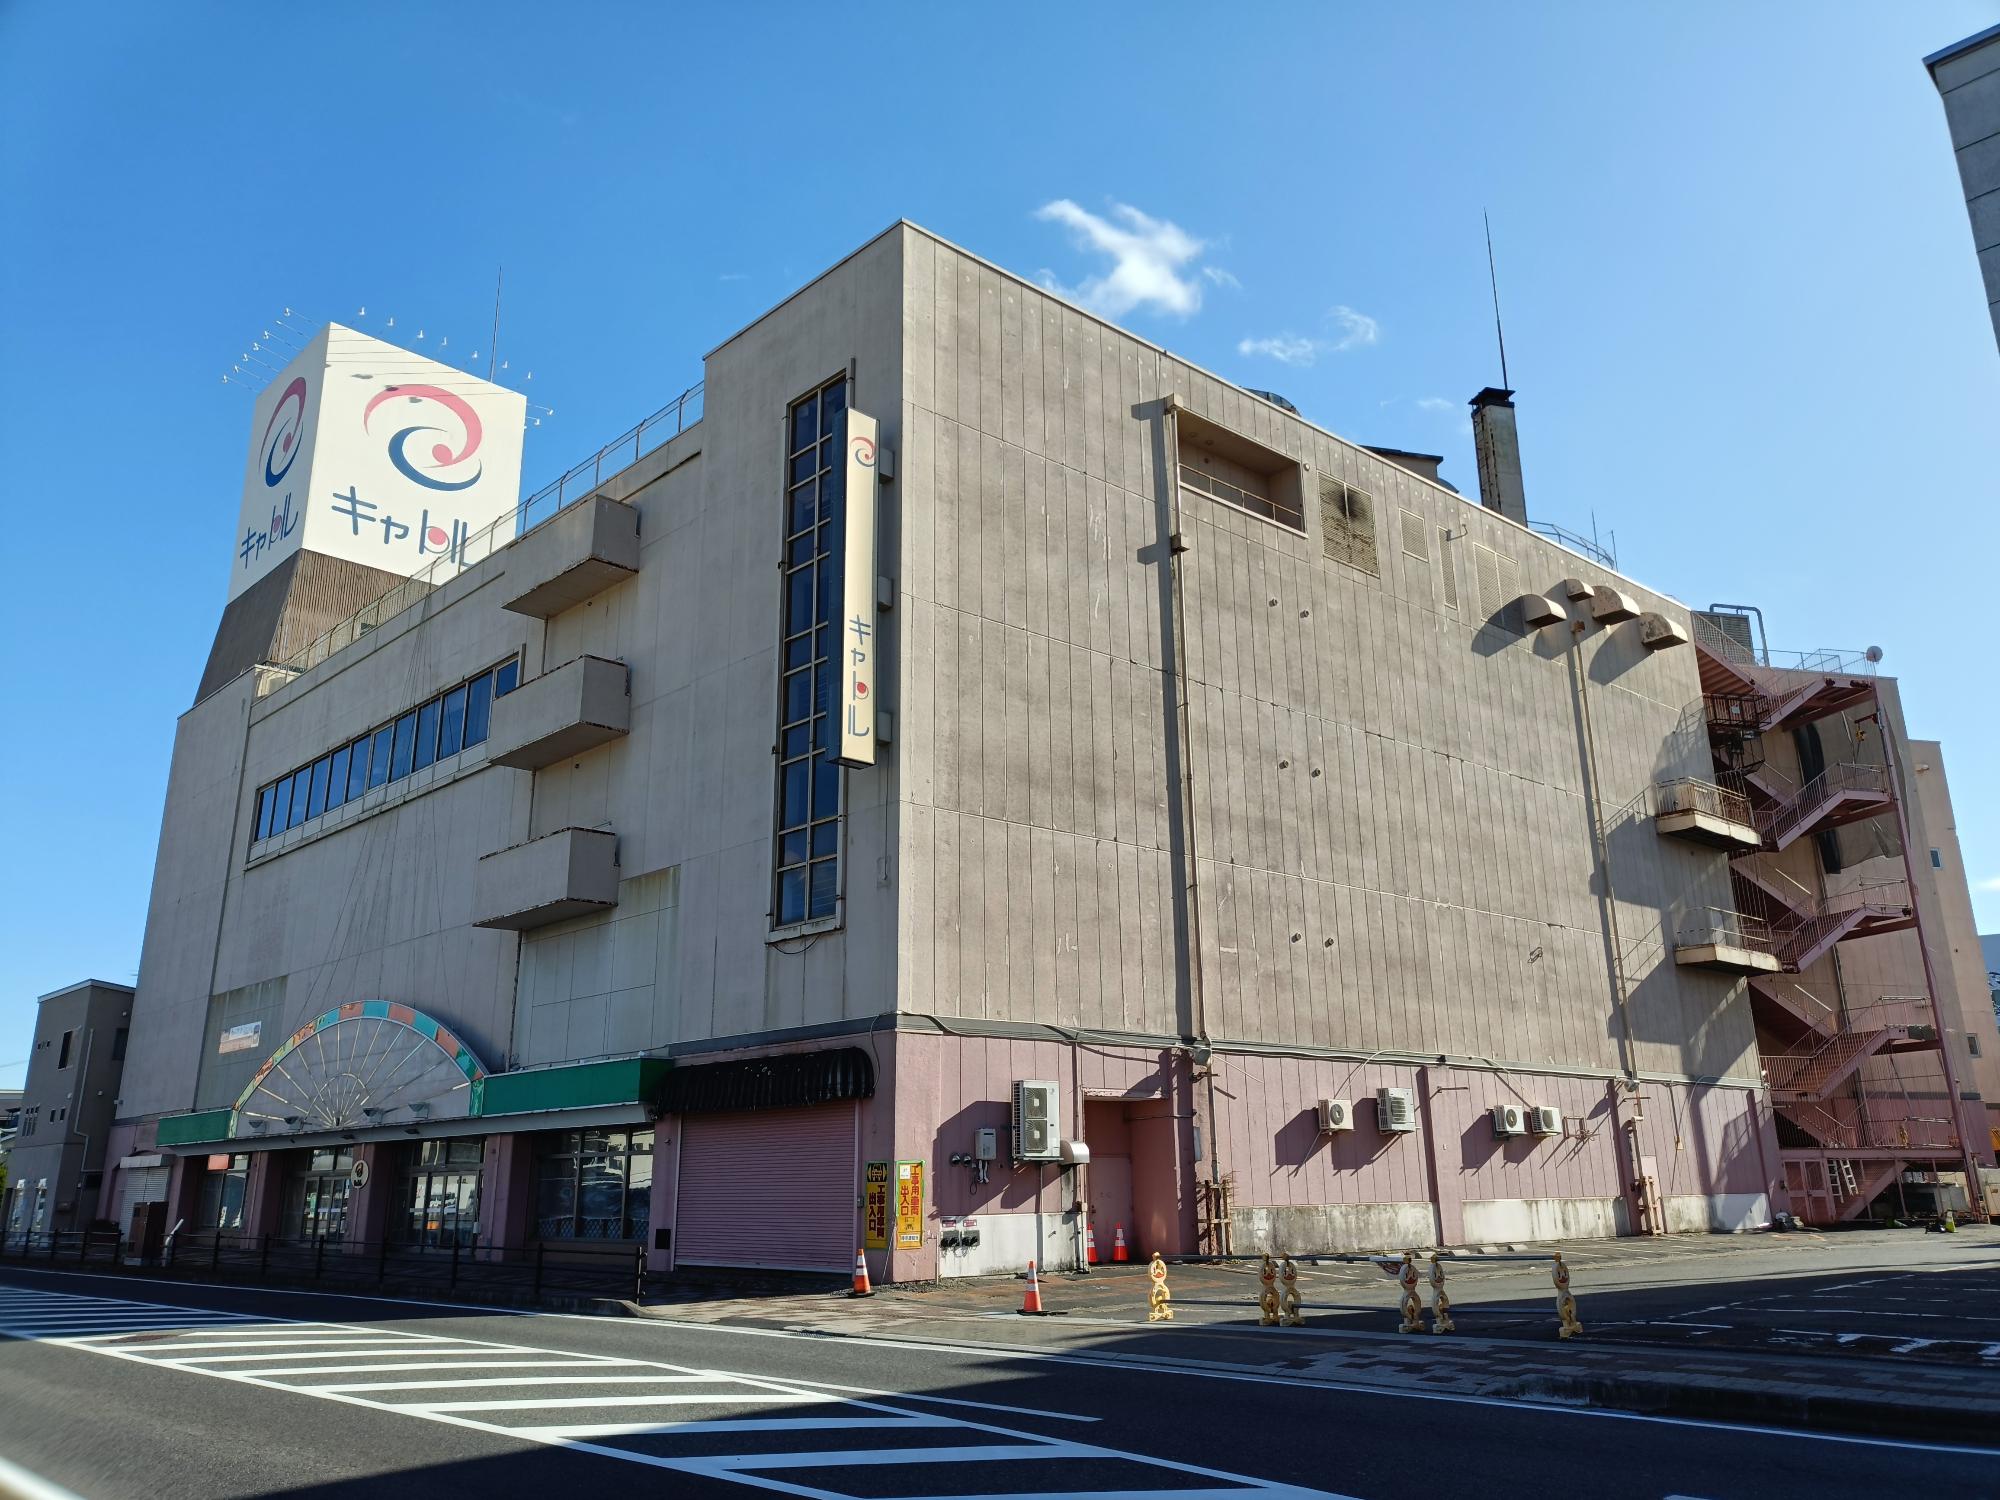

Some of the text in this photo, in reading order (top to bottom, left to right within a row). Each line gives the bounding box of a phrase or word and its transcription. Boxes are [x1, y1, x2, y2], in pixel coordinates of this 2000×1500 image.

[240, 492, 299, 569] キャトル
[331, 486, 475, 568] キャトル
[848, 614, 871, 737] キャトル
[868, 1192, 876, 1232] 出入口
[900, 1185, 909, 1216] 出入口
